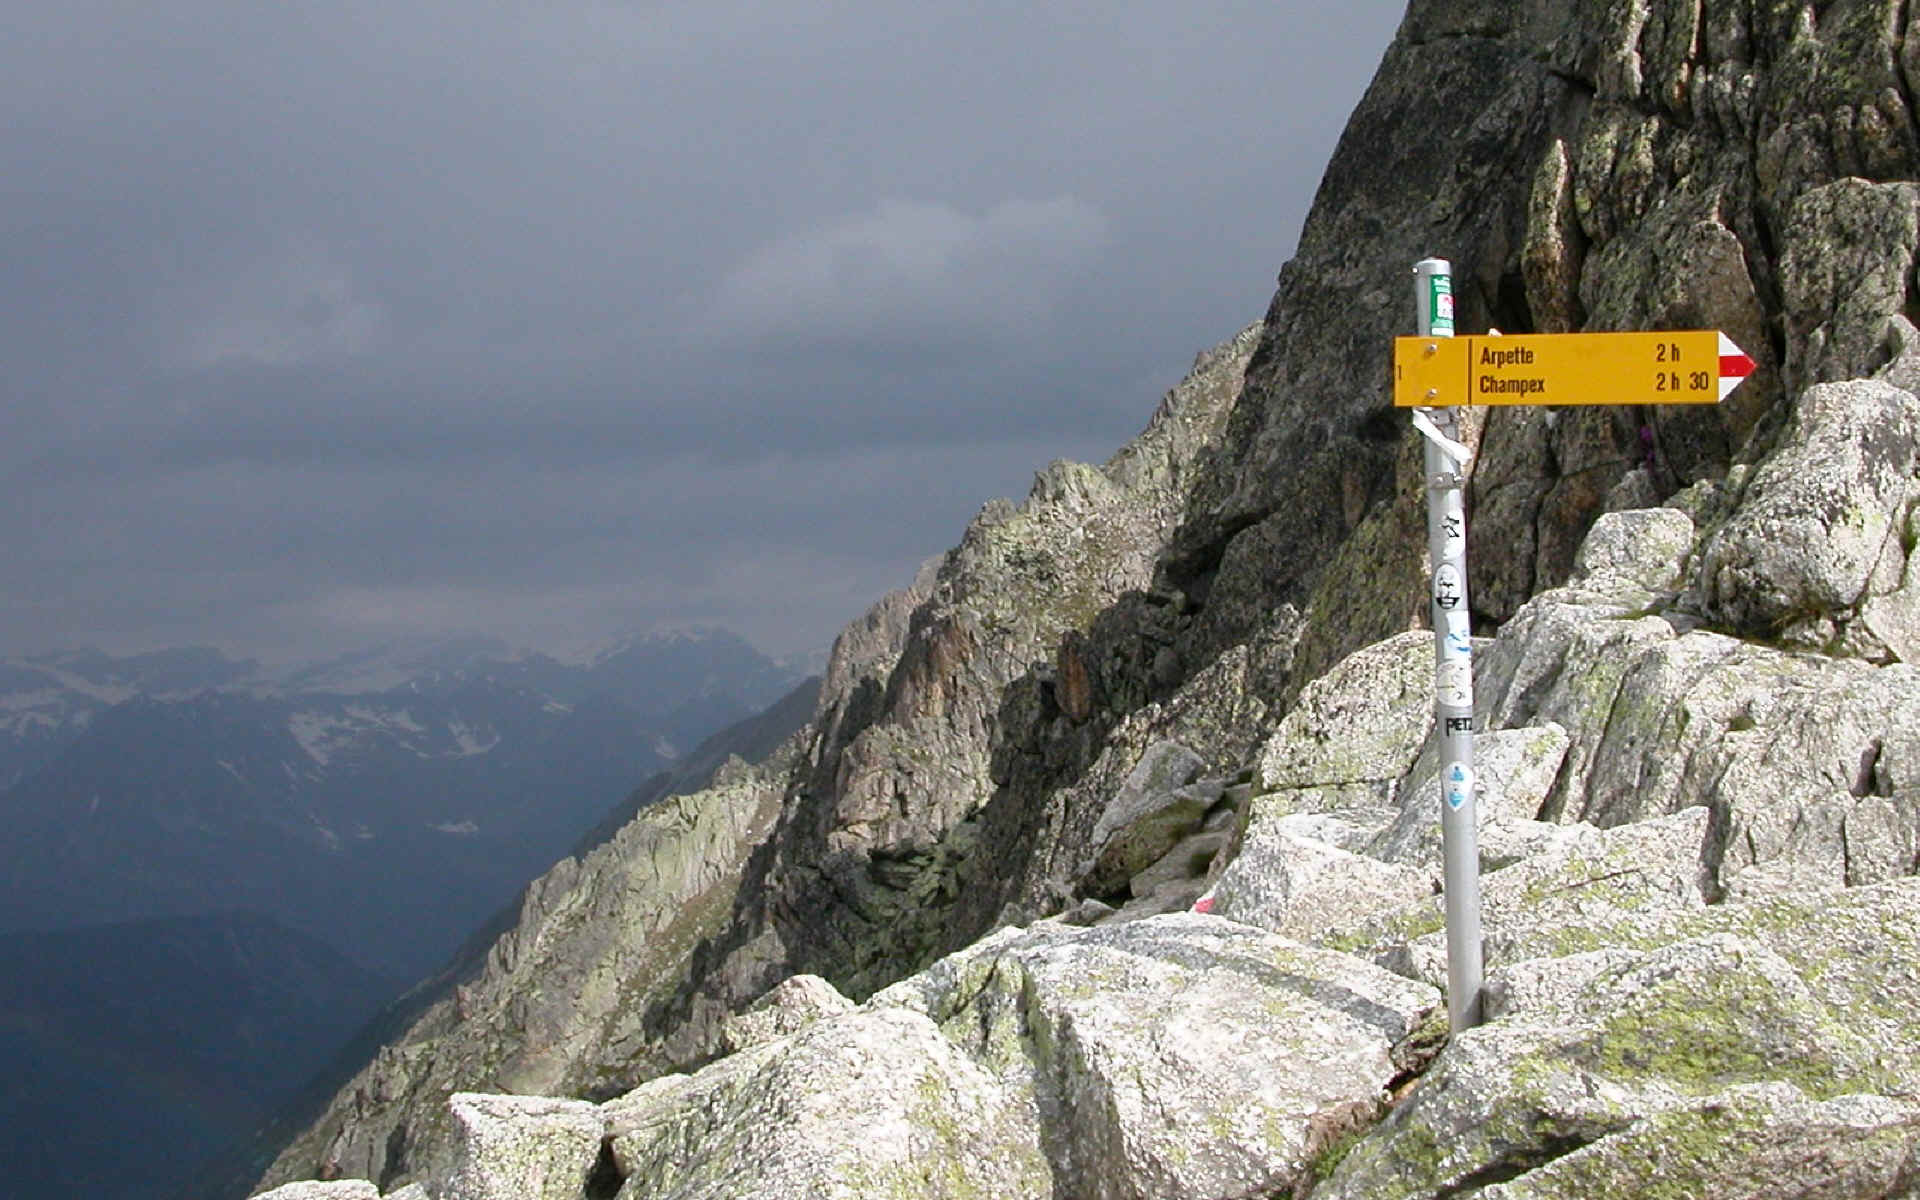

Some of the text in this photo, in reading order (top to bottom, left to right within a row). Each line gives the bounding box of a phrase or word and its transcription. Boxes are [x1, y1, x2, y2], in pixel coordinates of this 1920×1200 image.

[1480, 343, 1680, 368] Arpette 2 h
[1480, 371, 1709, 398] Champex 2 h 30
